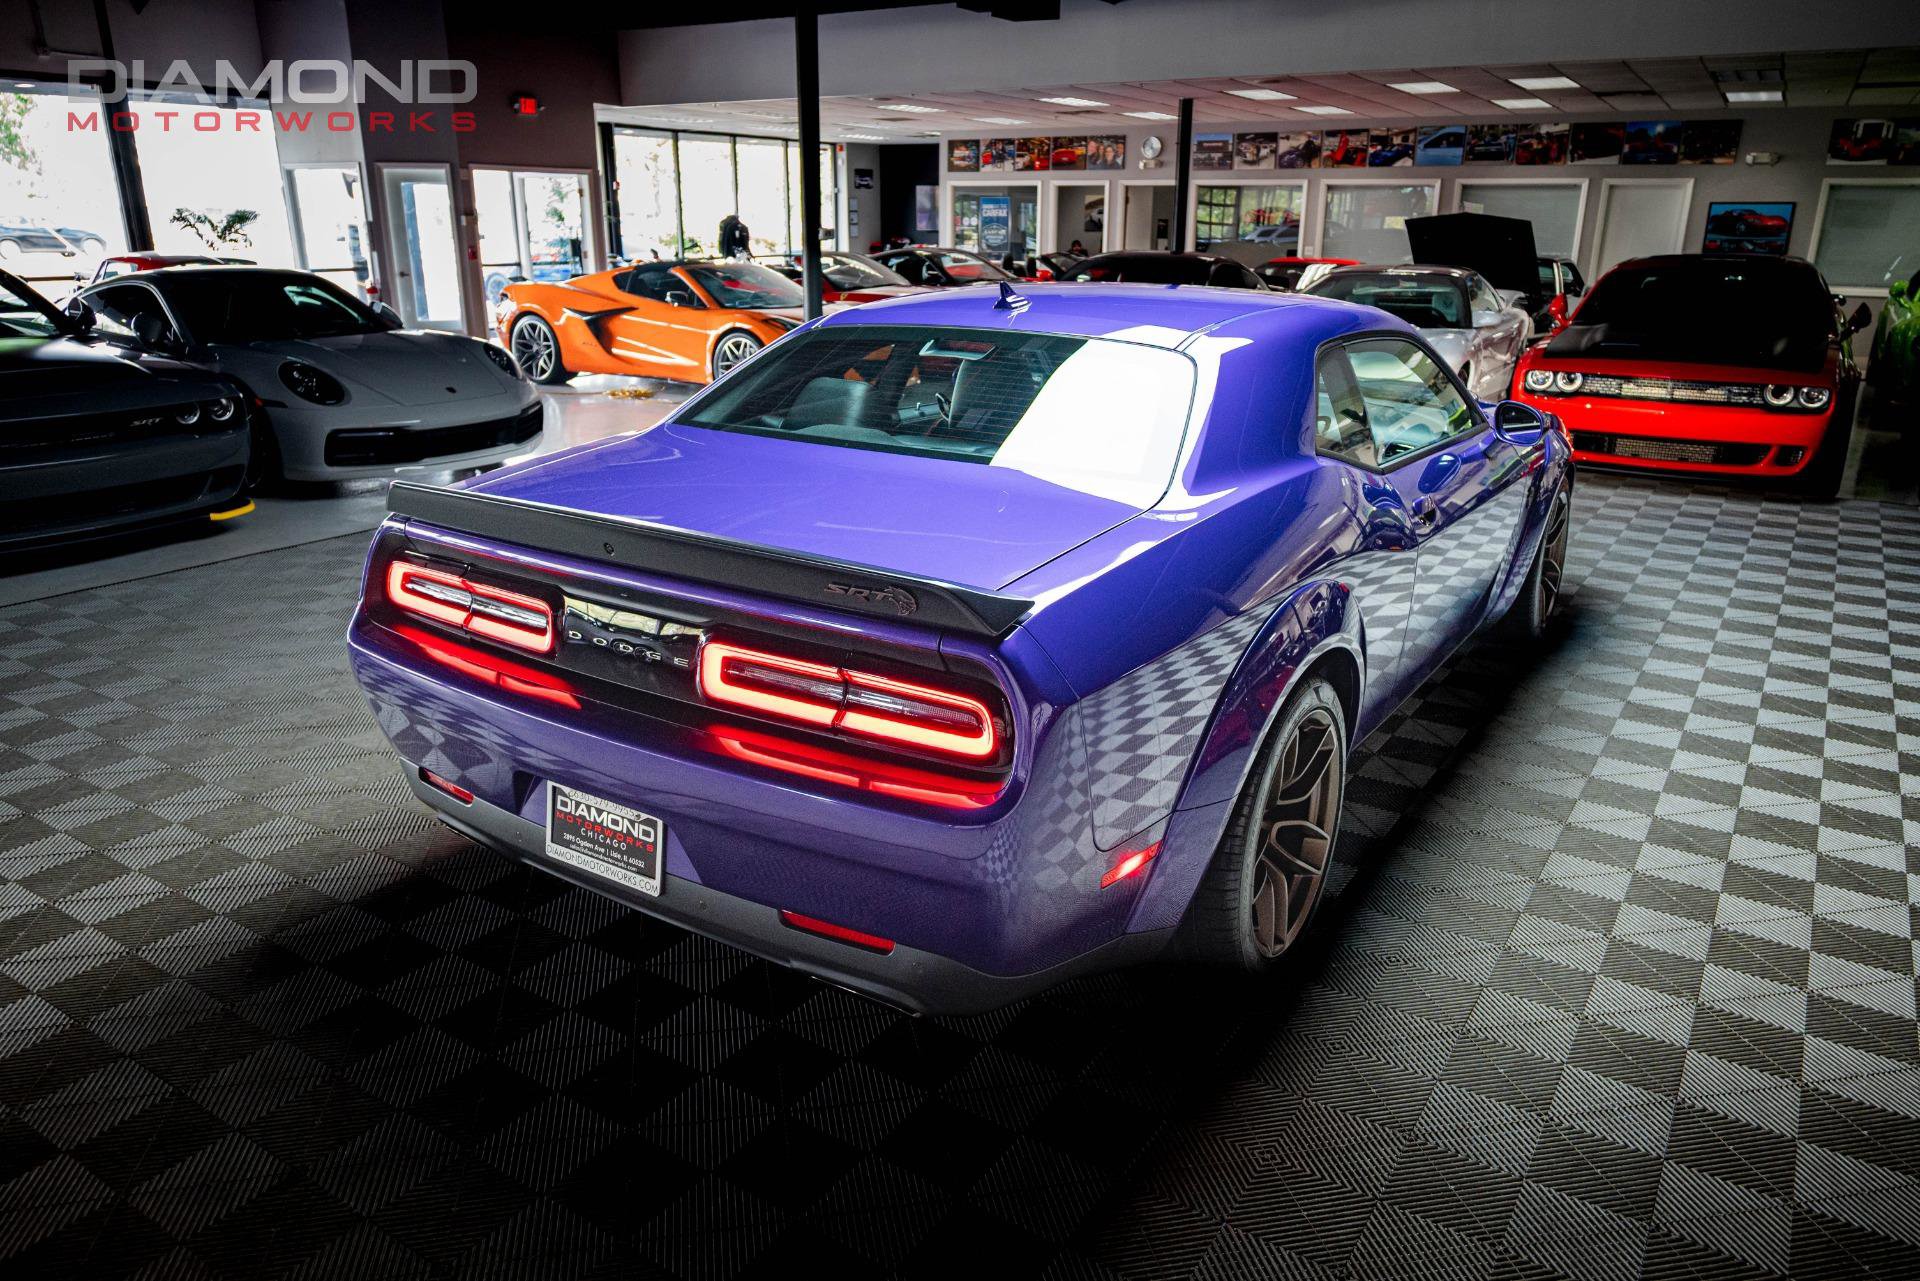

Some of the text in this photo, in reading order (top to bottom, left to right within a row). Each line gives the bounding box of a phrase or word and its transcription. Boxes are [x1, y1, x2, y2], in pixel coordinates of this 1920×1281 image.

[824, 583, 893, 601] SRT
[568, 630, 689, 668] DODGE
[556, 795, 655, 842] DIAMOND
[556, 811, 655, 853] MOTORWORKS
[576, 837, 594, 849] Ogden
[594, 845, 605, 853] Ave
[629, 855, 645, 868] 60532
[580, 828, 627, 850] CHICAGO
[546, 844, 659, 894] DIAMONDMOTORWORKS.COM
